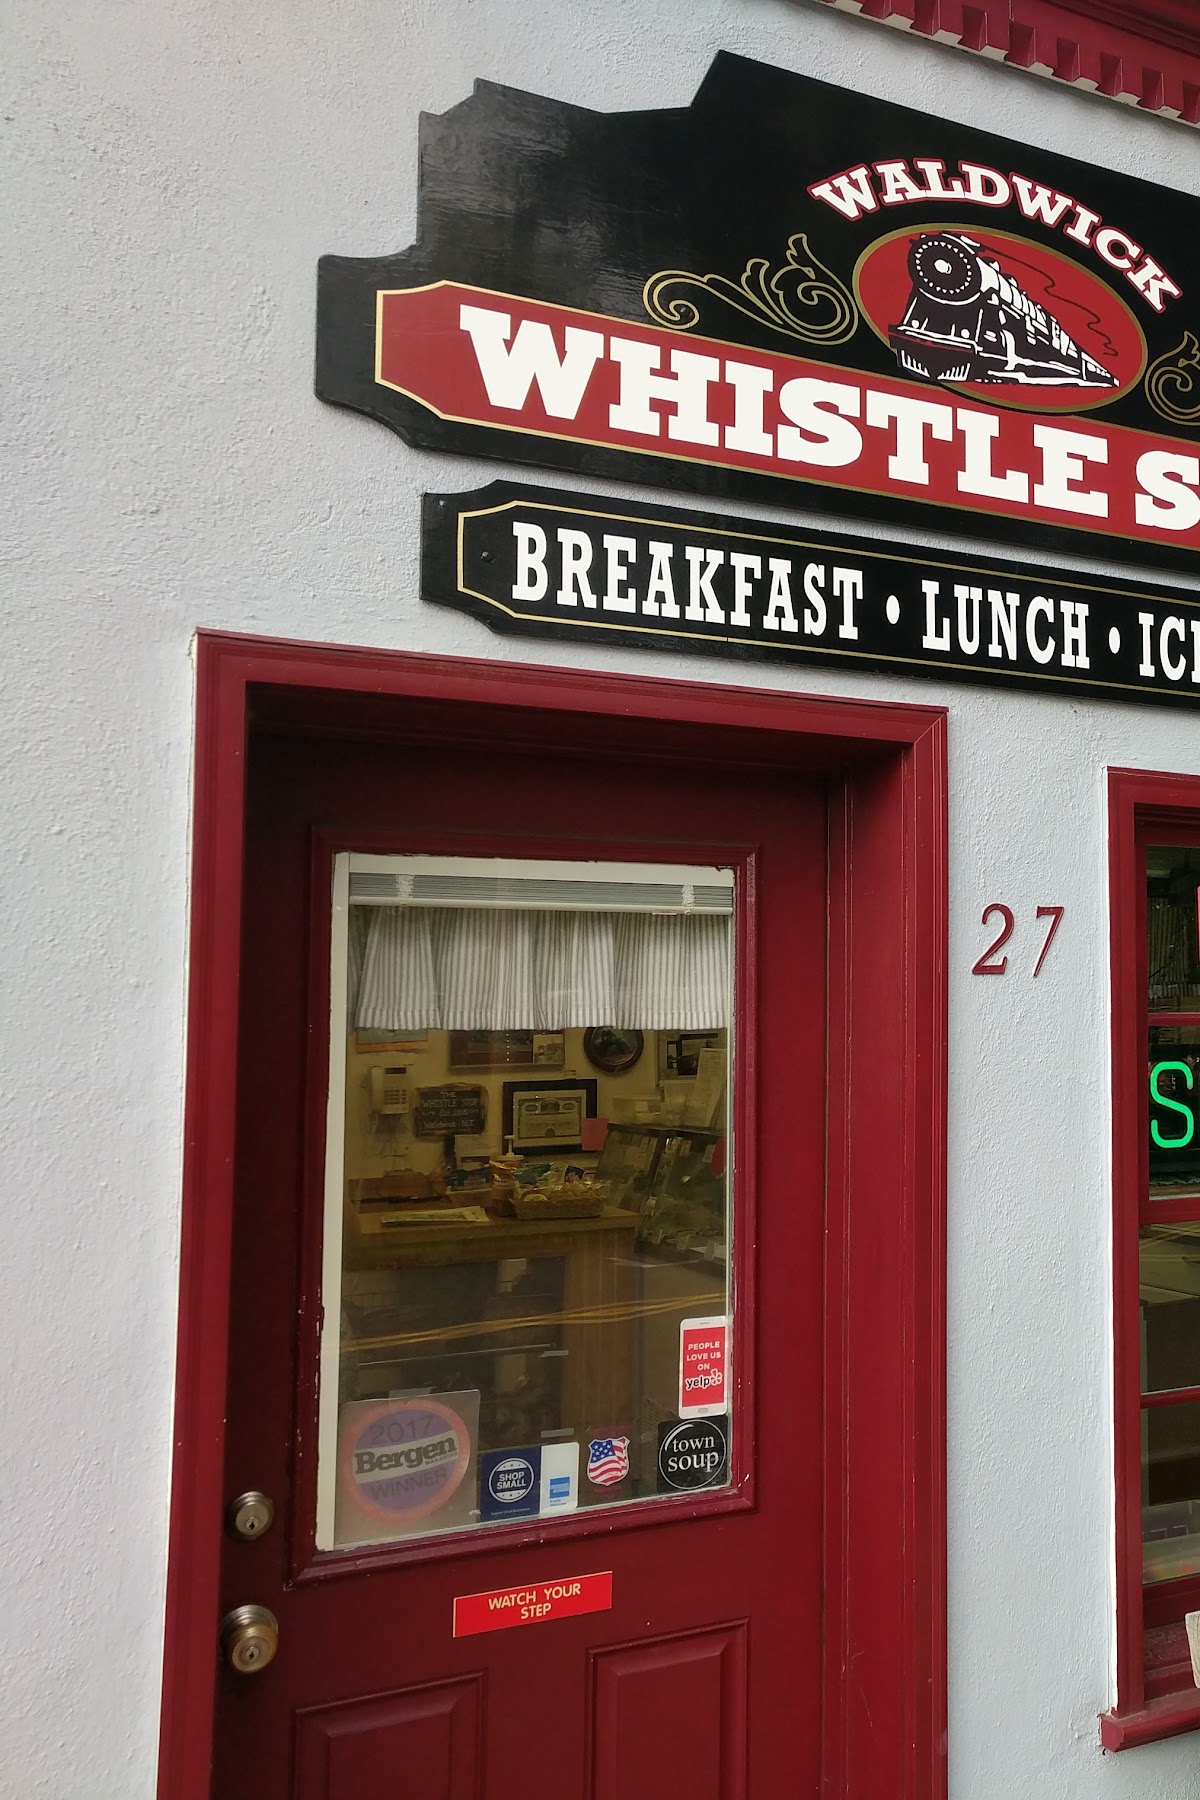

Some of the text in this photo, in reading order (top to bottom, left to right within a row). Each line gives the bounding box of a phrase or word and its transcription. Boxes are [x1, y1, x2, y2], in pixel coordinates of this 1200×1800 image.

[808, 159, 1182, 312] WALDWICK
[459, 304, 1109, 518] WHISTLE
[512, 521, 864, 641] BREAKFAST
[921, 579, 1091, 670] LUNCH
[971, 903, 1065, 978] 27
[686, 1353, 708, 1361] LOVE
[688, 1341, 720, 1350] PEOPLE
[686, 1374, 711, 1389] yelp
[369, 1414, 435, 1445] 2017
[354, 1437, 458, 1475] Bergen
[672, 1436, 715, 1453] town
[667, 1451, 719, 1472] soup
[369, 1467, 448, 1499] WINNER
[496, 1479, 527, 1490] SMALL
[499, 1471, 525, 1482] SHOP
[488, 1583, 581, 1610] WATCH YOUR
[520, 1602, 552, 1619] STEP
